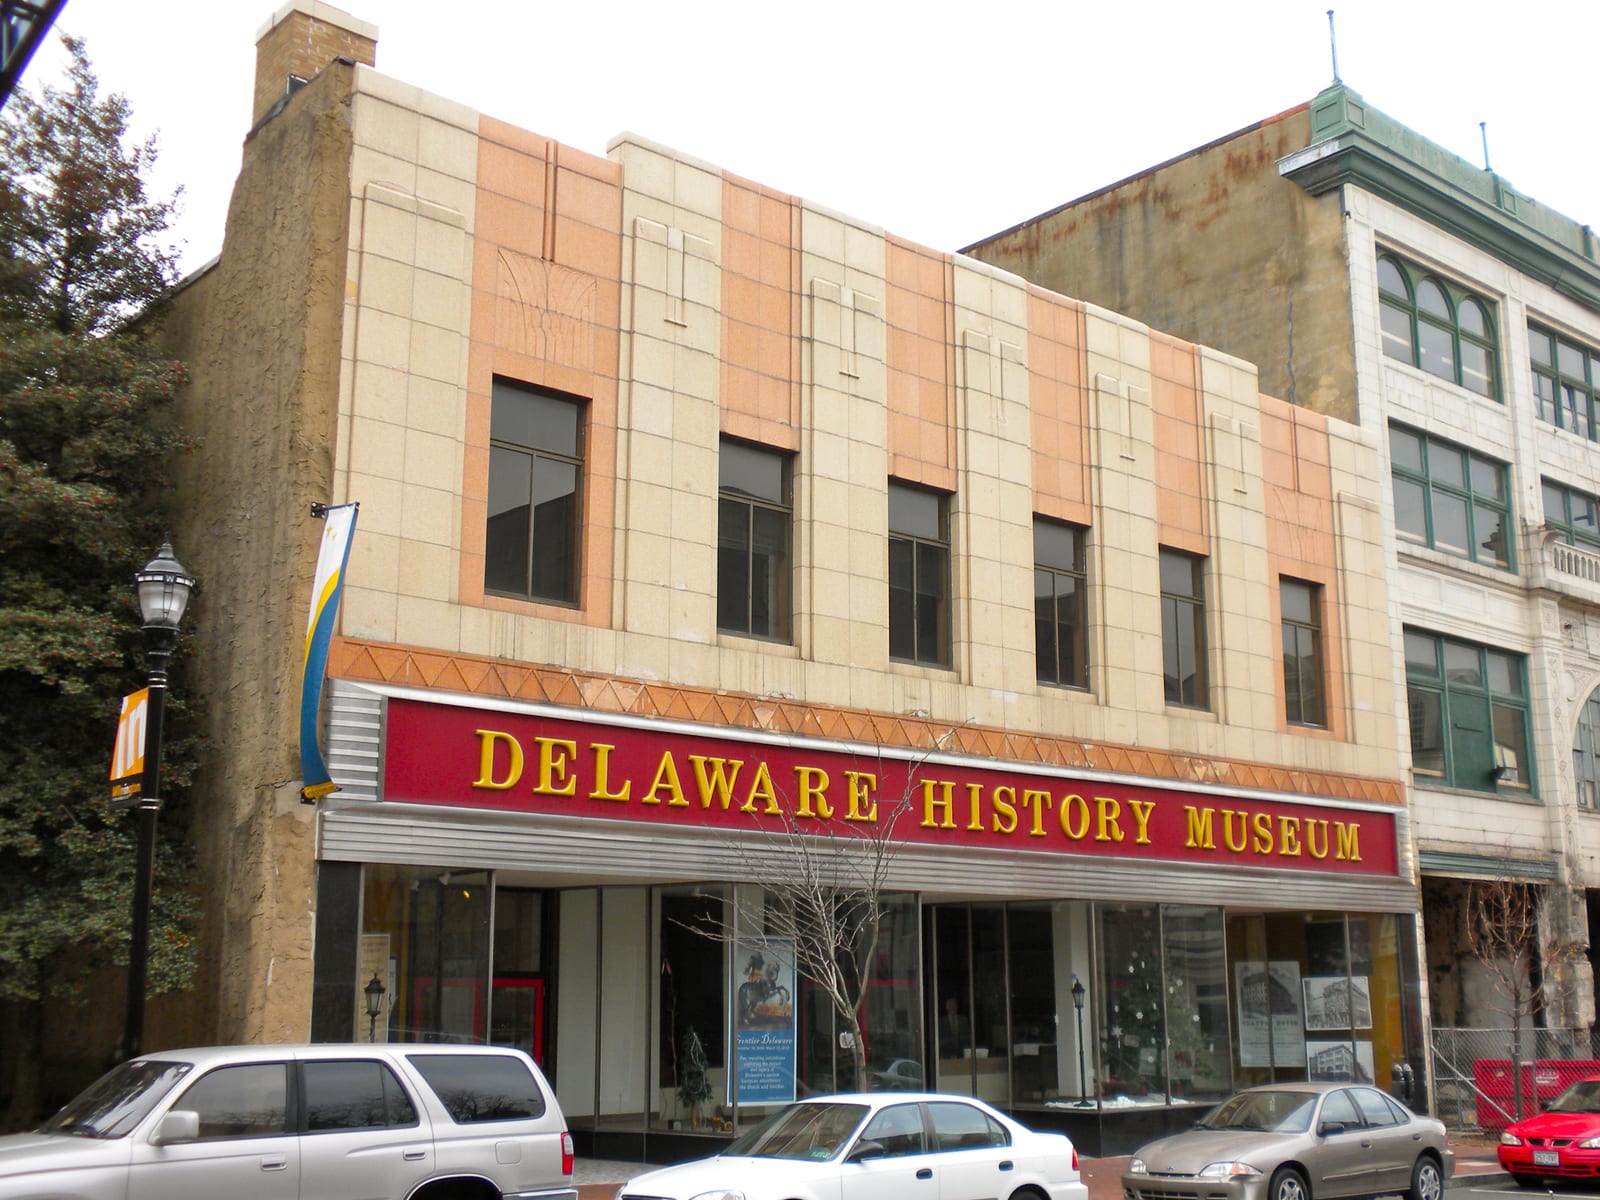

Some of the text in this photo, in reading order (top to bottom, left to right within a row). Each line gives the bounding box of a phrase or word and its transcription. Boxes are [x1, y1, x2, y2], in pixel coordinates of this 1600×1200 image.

[471, 728, 1363, 861] DELAWARE HISTORY MUSEUM
